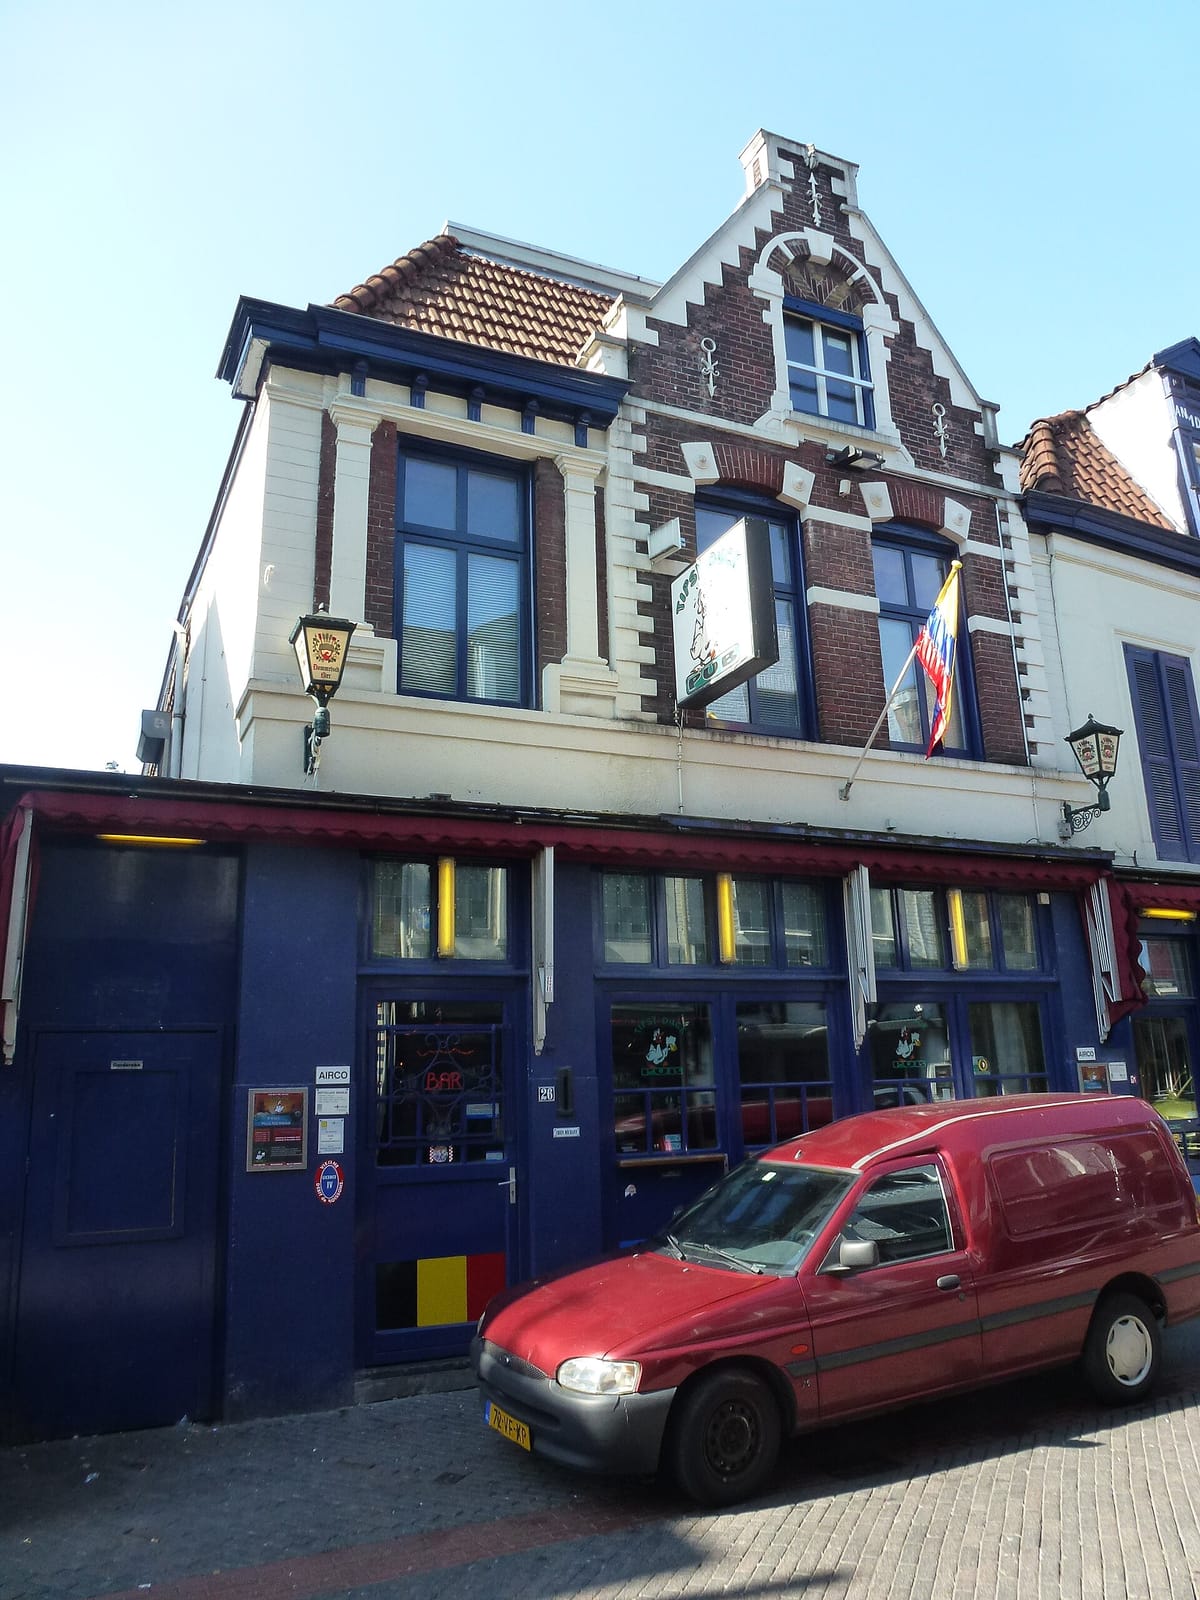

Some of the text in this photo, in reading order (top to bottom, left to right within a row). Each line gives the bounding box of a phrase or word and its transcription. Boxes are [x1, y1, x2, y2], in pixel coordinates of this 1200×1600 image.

[689, 650, 738, 692] PUB
[318, 1071, 348, 1080] AIRCO
[641, 1067, 683, 1076] PUB
[426, 1072, 462, 1090] BAR
[540, 1087, 553, 1100] 26
